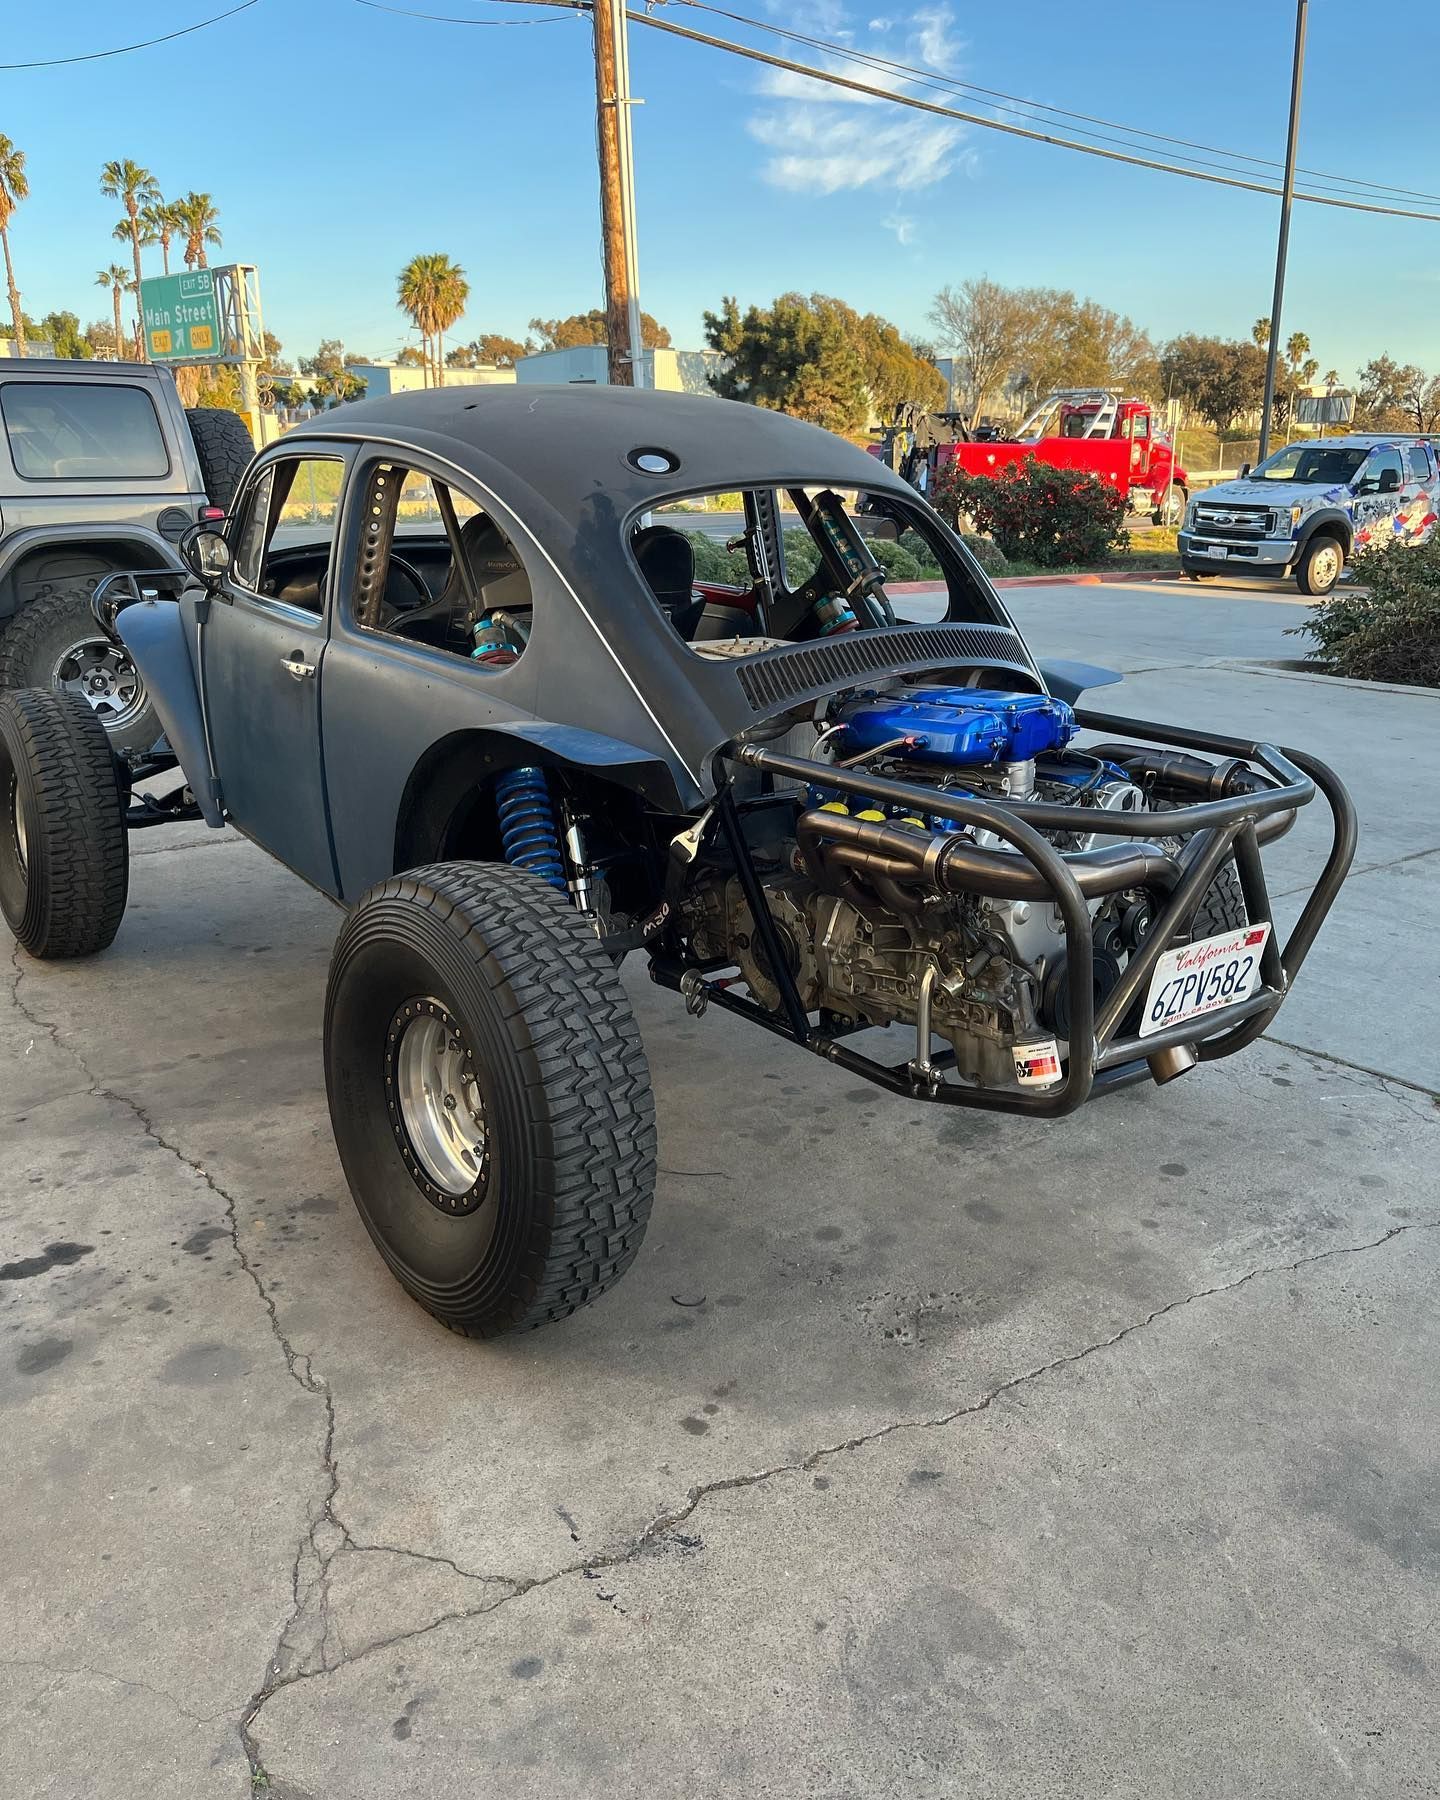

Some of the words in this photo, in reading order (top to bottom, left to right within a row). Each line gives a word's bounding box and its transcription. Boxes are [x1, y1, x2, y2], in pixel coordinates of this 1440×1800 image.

[183, 279, 196, 290] EXIT
[145, 308, 171, 327] Main
[175, 301, 213, 323] Street
[153, 335, 168, 348] EXIT
[192, 332, 210, 345] ONLY
[1176, 941, 1245, 972] California
[1151, 956, 1254, 1022] 6ZPV582
[1167, 999, 1224, 1025] dmv.ca.gov
